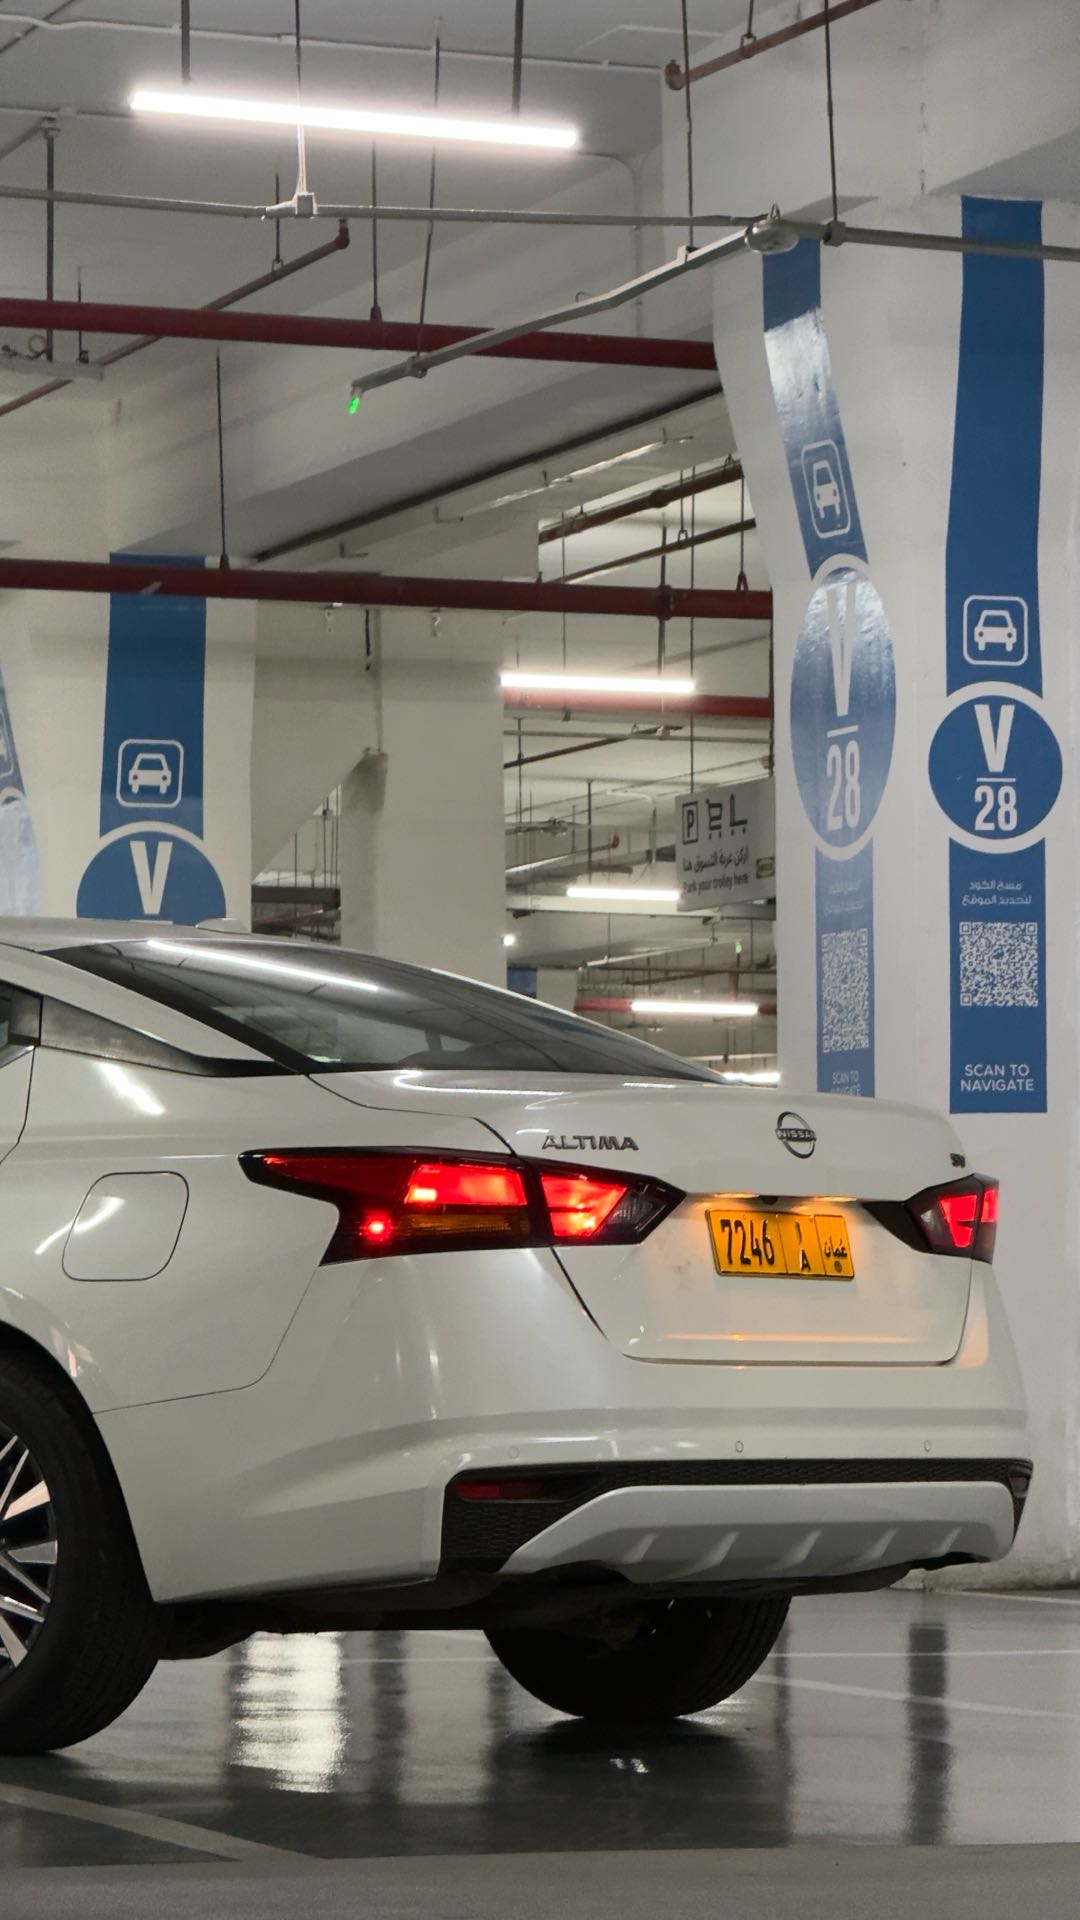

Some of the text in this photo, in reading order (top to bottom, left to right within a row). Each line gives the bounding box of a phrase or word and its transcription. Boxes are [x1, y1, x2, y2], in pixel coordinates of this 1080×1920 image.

[826, 584, 857, 716] V
[974, 704, 1016, 773] V
[826, 740, 861, 831] 28
[974, 785, 1018, 831] 28
[686, 809, 695, 838] P
[130, 840, 173, 914] V
[969, 880, 1023, 891] مسح الكود
[961, 894, 997, 906] الموقع
[964, 1064, 1030, 1077] SCAN TO
[960, 1079, 1034, 1092] NAVIGATE
[542, 1135, 639, 1151] ALTIMA
[776, 1129, 816, 1141] NISSAN
[720, 1219, 775, 1266] 7246
[801, 1249, 811, 1271] A
